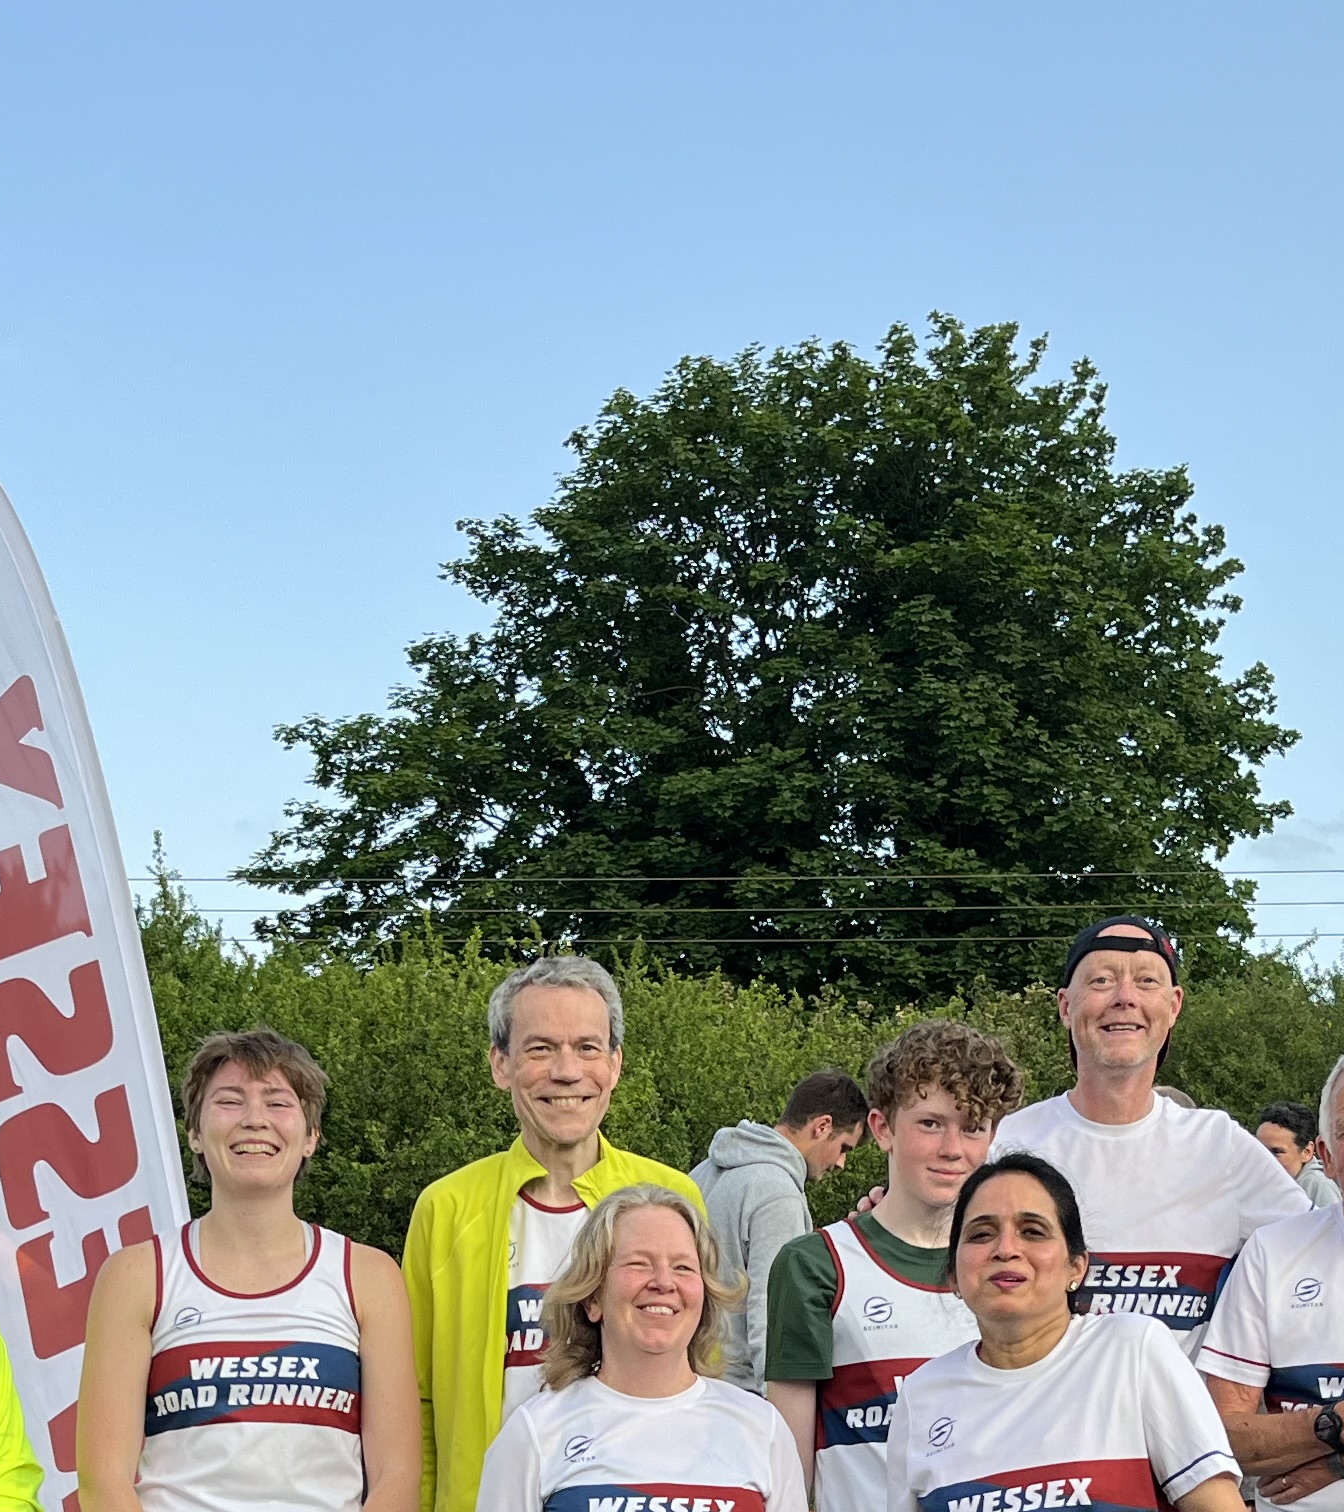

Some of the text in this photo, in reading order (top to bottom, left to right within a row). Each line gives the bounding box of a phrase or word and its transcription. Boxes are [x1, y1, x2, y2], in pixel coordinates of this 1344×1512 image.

[1084, 1264, 1182, 1288] ESSEX
[1089, 1293, 1208, 1318] RUNNERS
[505, 1328, 544, 1354] AD
[189, 1356, 320, 1381] WESSEX
[154, 1384, 356, 1417] ROAD RUNNERS
